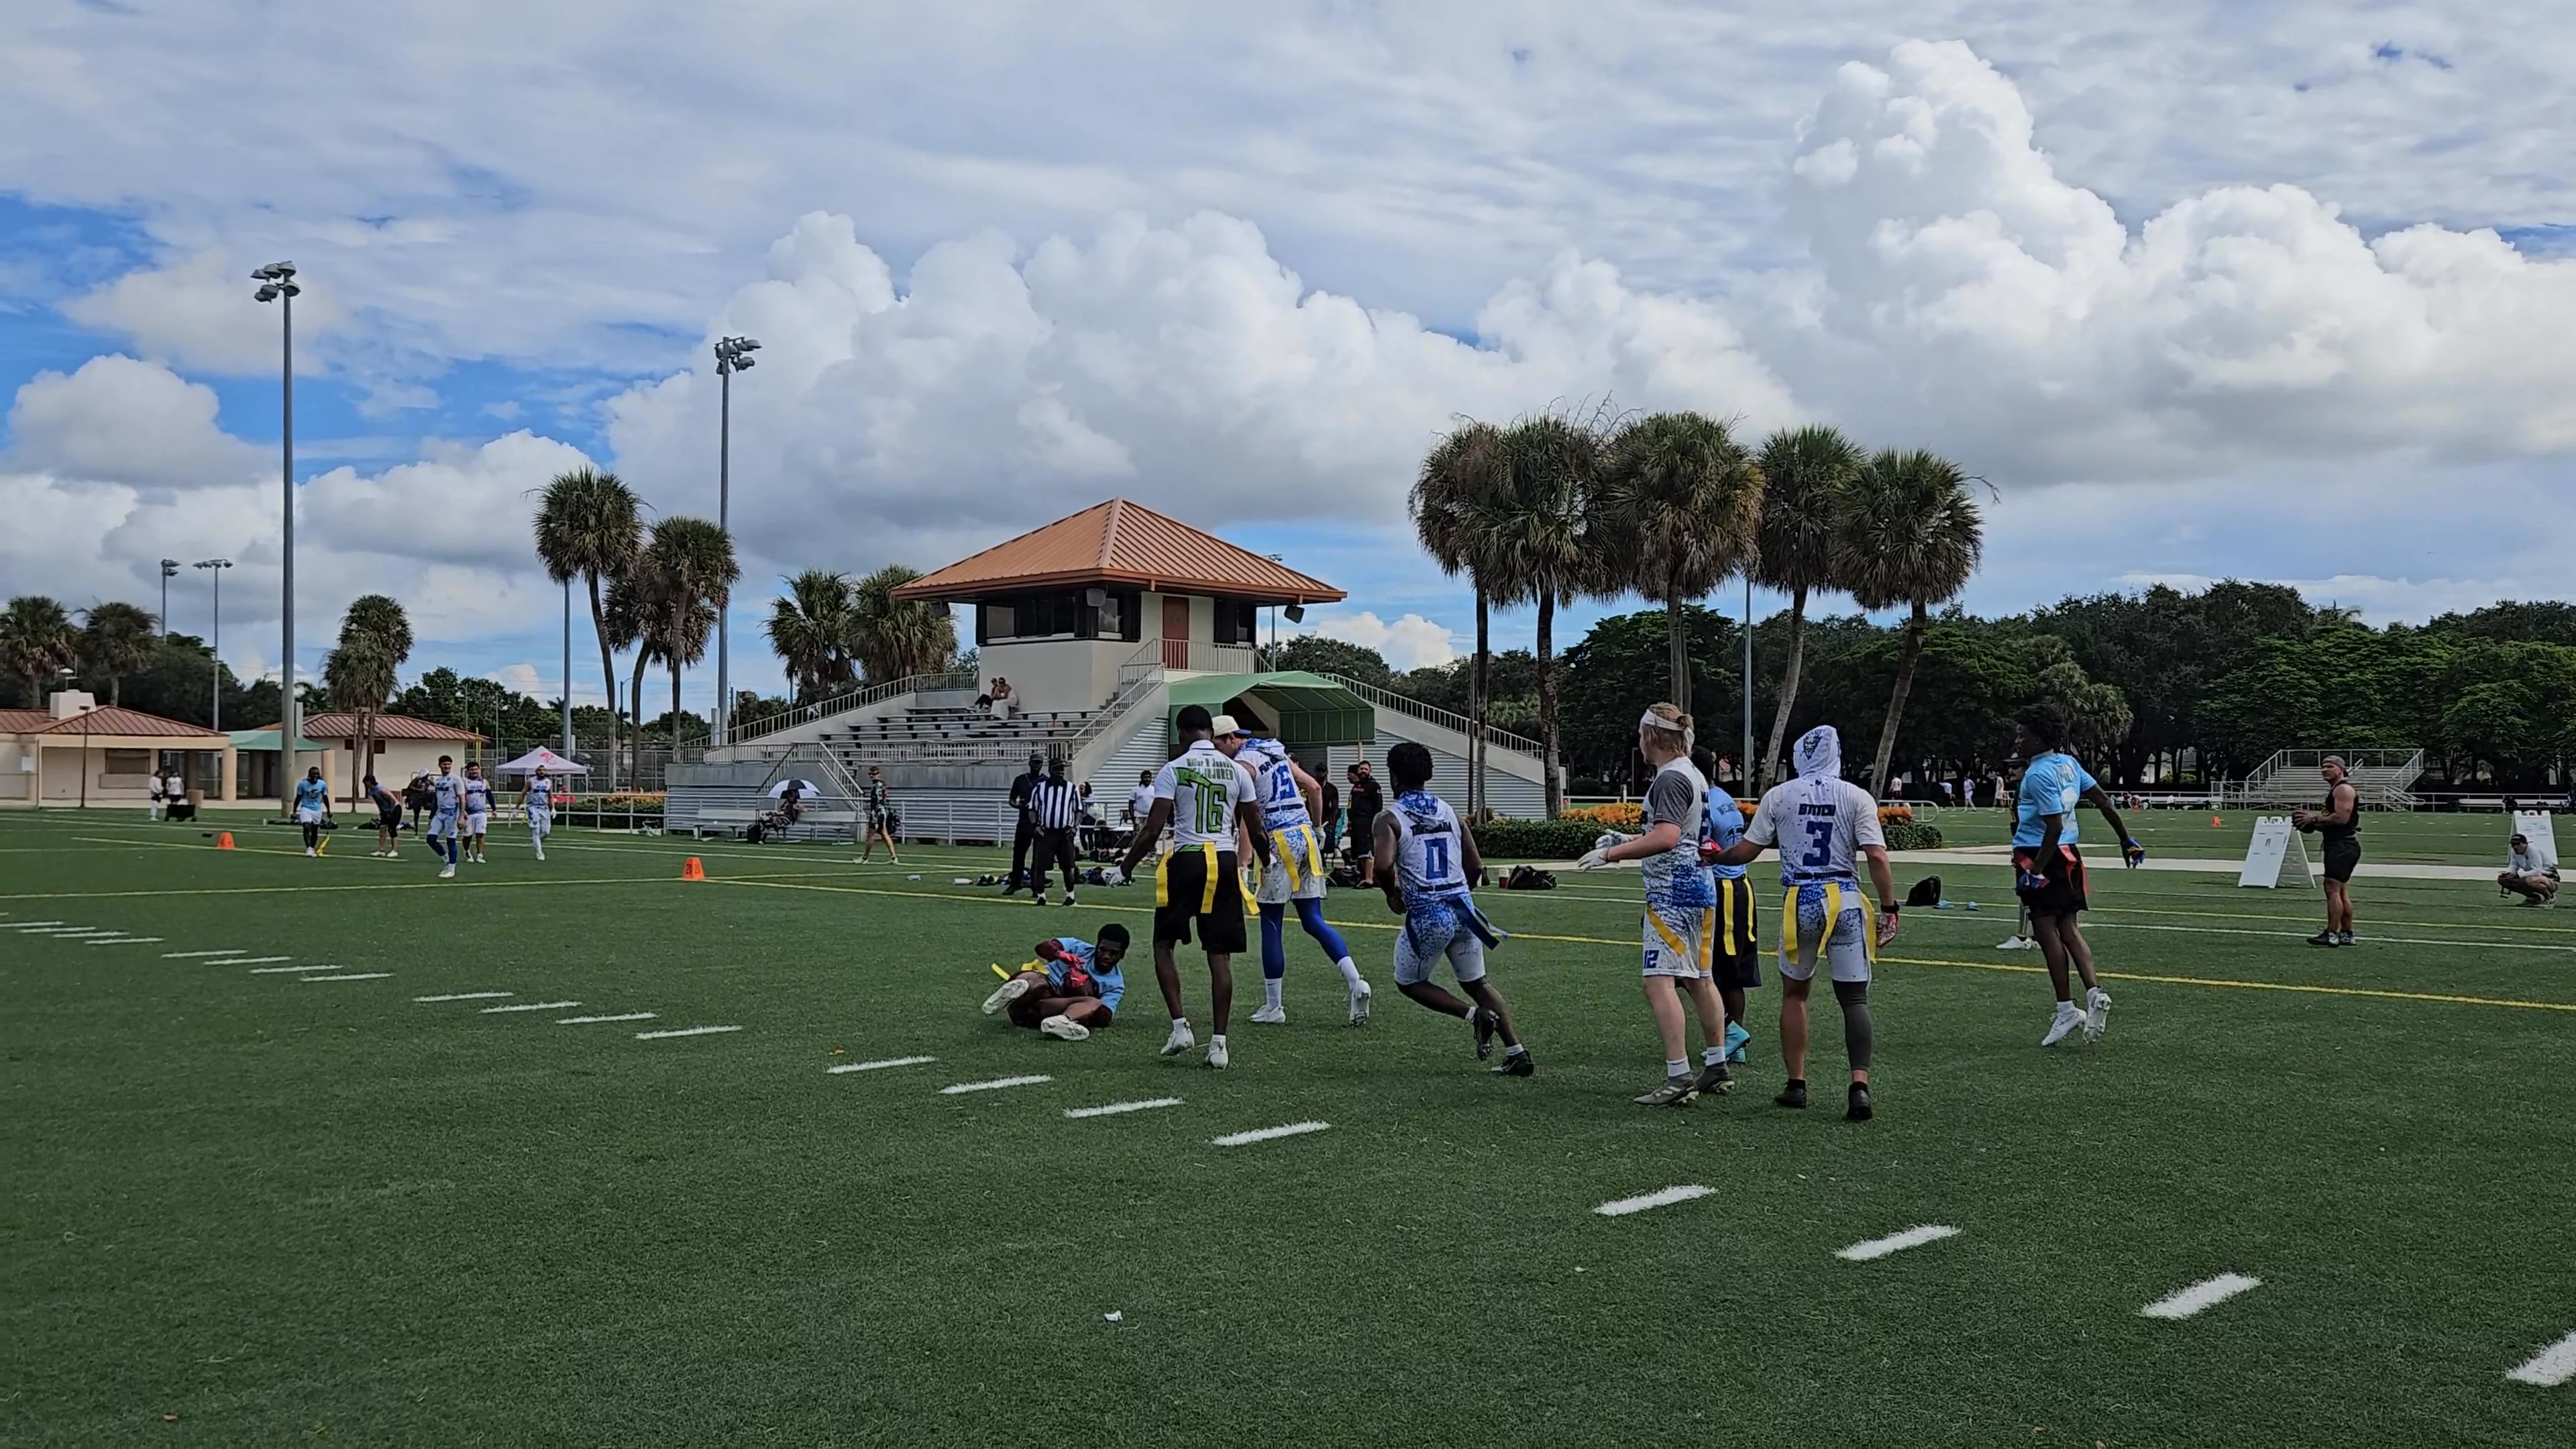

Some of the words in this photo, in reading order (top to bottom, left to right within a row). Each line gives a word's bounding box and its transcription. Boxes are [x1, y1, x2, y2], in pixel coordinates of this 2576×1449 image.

[1195, 782, 1226, 833] 16
[1424, 837, 1448, 879] 0
[1803, 820, 1833, 866] 3
[1644, 950, 1660, 969] 12
